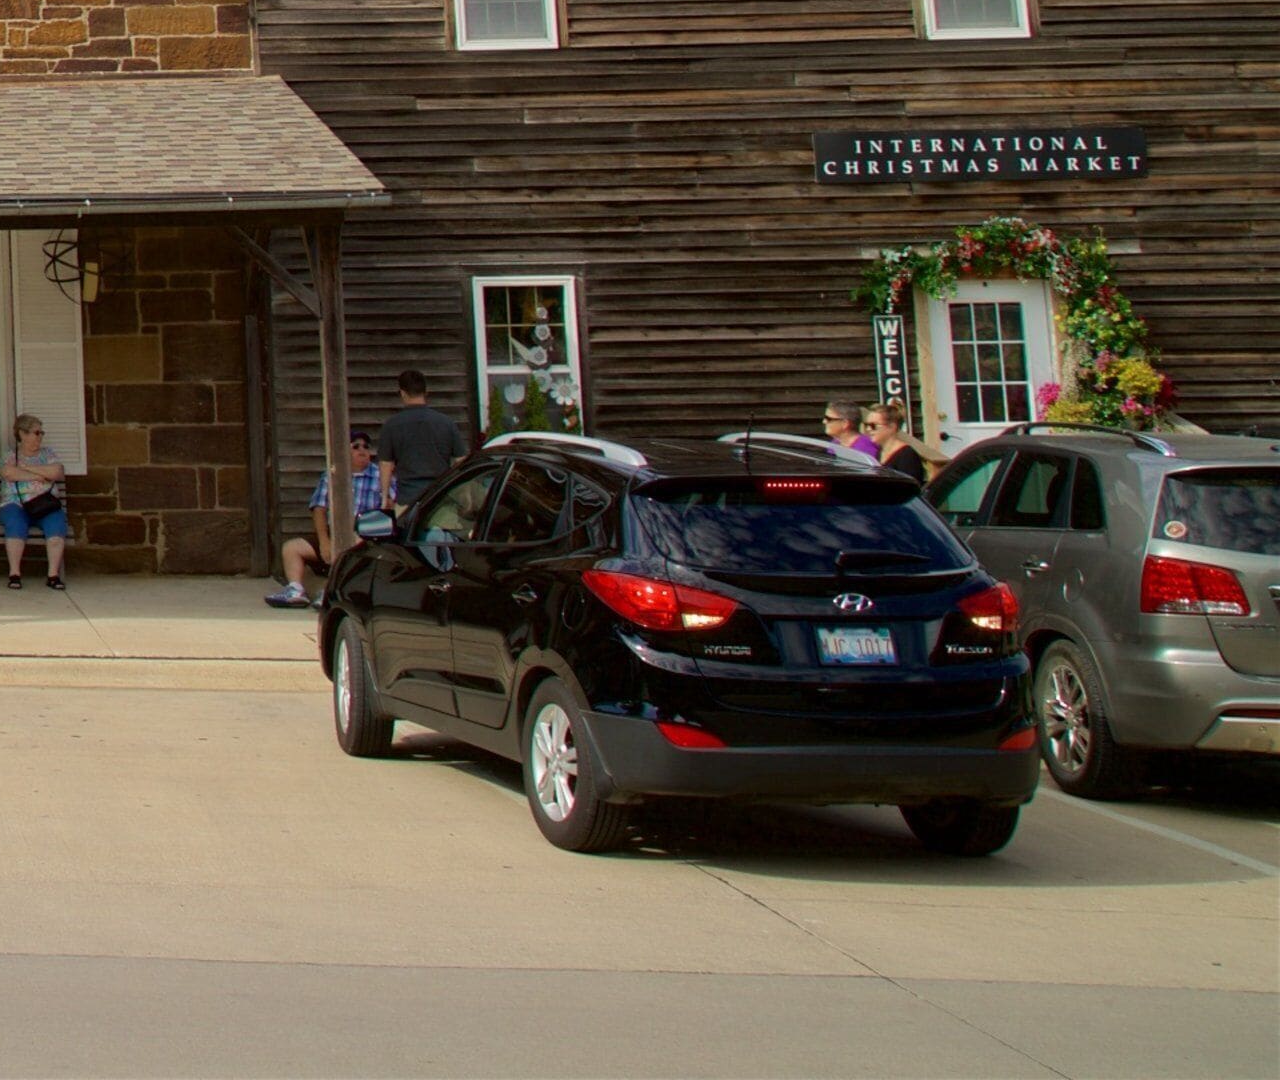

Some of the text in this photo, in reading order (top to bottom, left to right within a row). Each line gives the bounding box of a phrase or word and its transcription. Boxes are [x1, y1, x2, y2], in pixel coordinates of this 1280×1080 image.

[853, 135, 1108, 155] INTERNATIONAL
[823, 155, 1141, 175] CHRISTMAS MARKET
